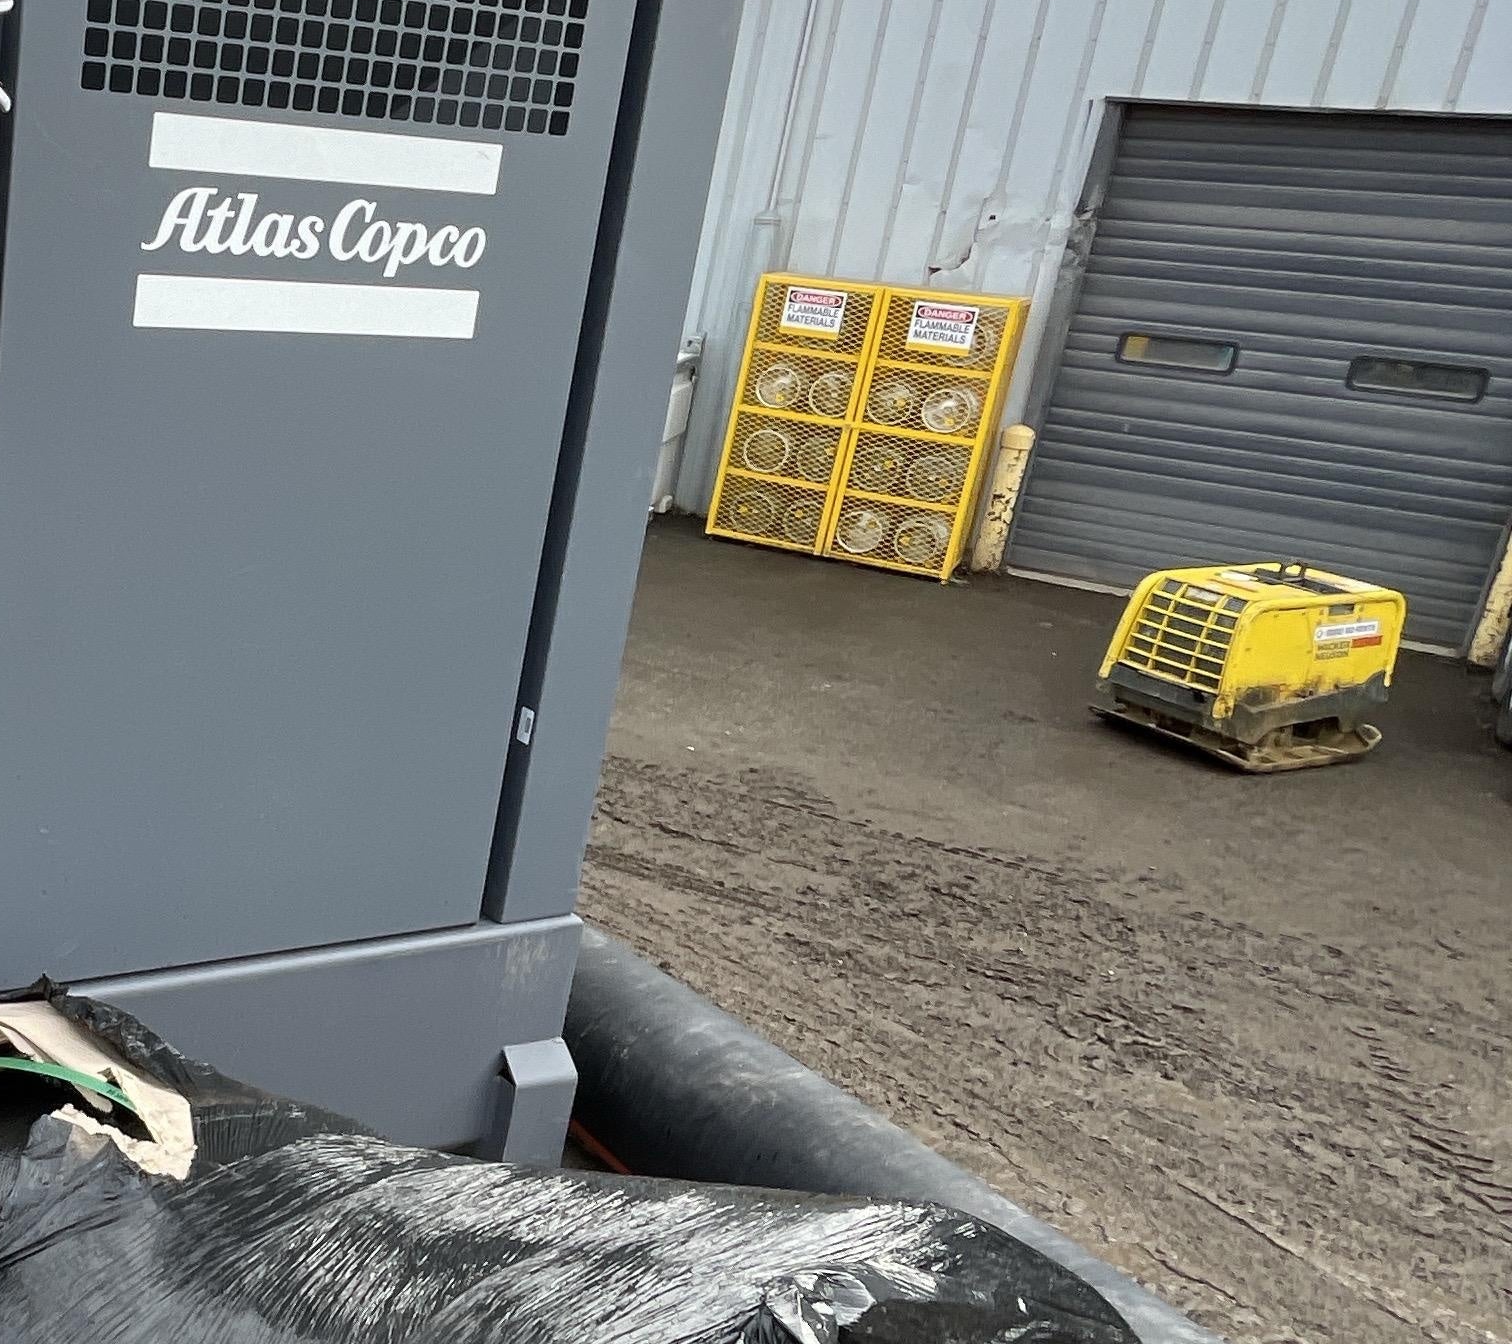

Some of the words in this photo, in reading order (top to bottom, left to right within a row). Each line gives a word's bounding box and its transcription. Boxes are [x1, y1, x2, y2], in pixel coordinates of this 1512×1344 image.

[141, 186, 325, 260] Atlas
[329, 198, 487, 278] Copco
[796, 291, 836, 307] DANGER
[788, 303, 839, 318] FLAMMABLE
[923, 306, 968, 322] DANGER
[787, 313, 836, 328] MATERIALS
[914, 319, 970, 334] FLAMMABLE
[913, 330, 966, 344] MATERIALS
